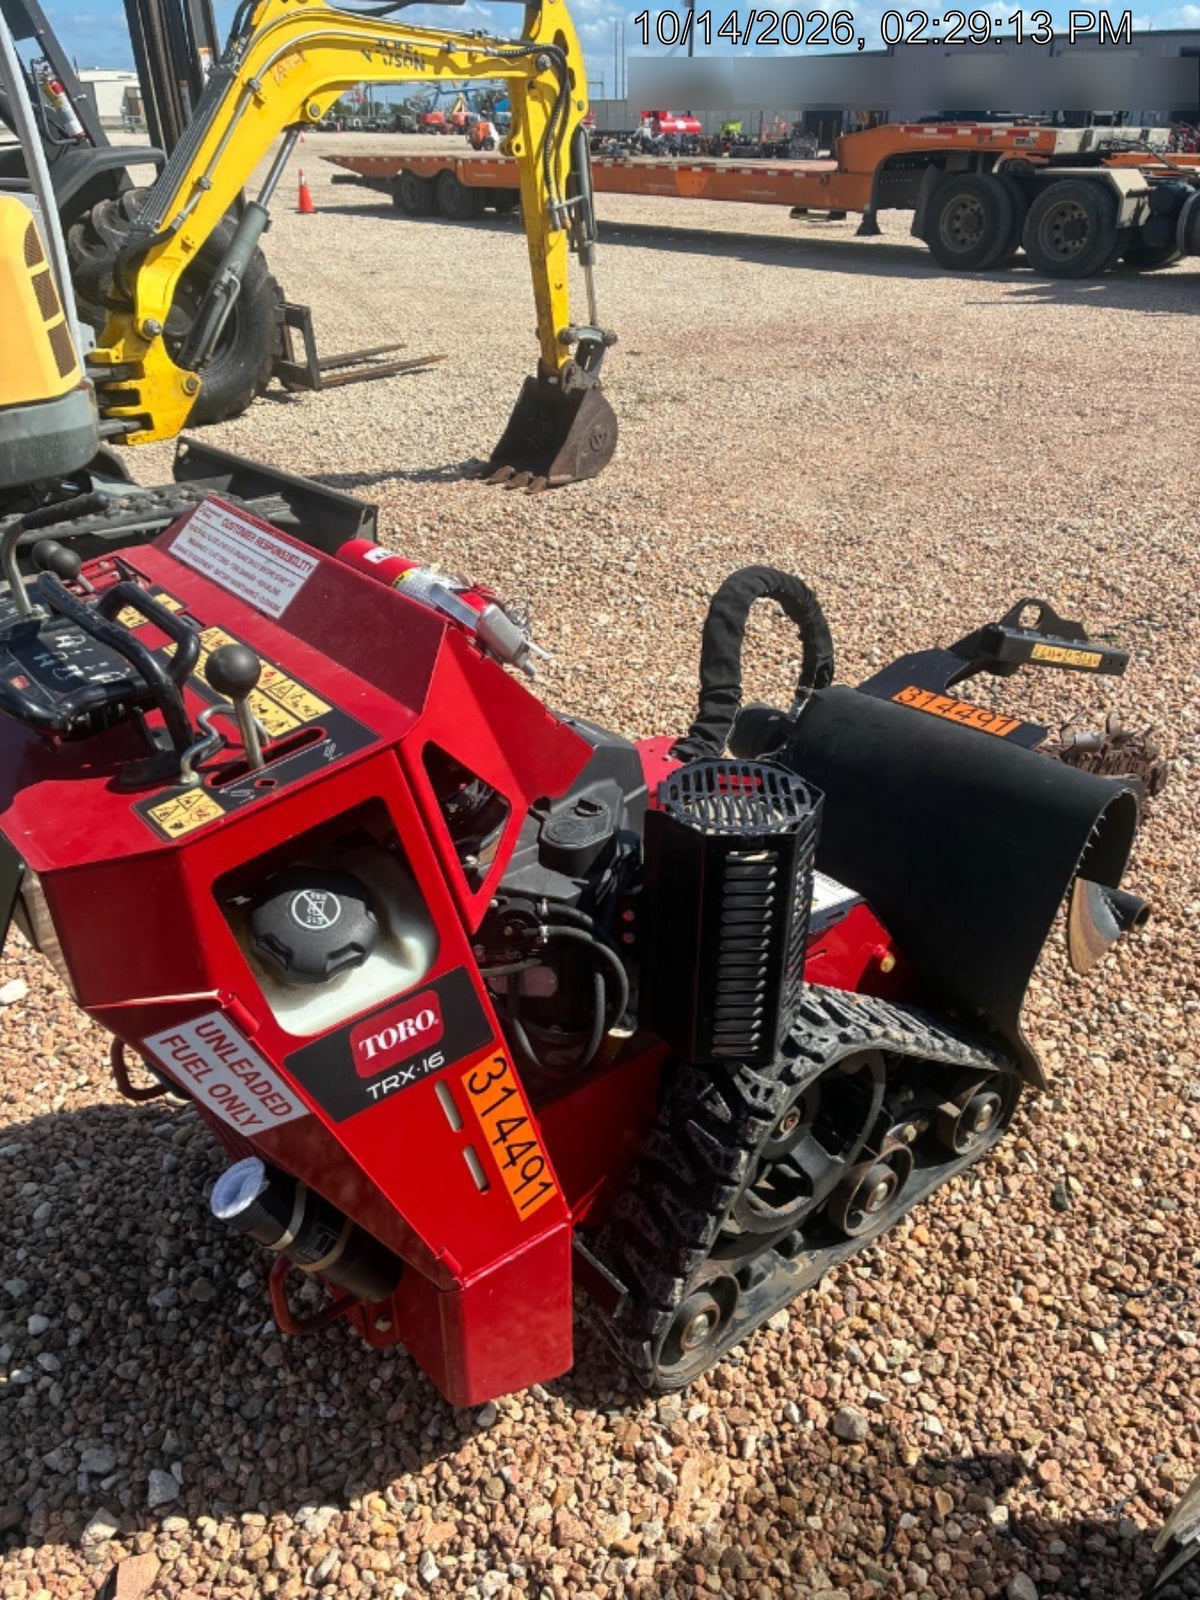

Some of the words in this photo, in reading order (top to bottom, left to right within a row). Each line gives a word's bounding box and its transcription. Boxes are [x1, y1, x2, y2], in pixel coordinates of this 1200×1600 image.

[220, 517, 256, 544] CUSTOMER
[255, 537, 315, 573] RESPONSIBILITY
[158, 1033, 214, 1084] FUEL
[207, 1083, 264, 1127] ONLY
[194, 1020, 293, 1117] UNLEADED
[358, 1008, 436, 1060] TORO
[468, 1057, 554, 1211] 314491
